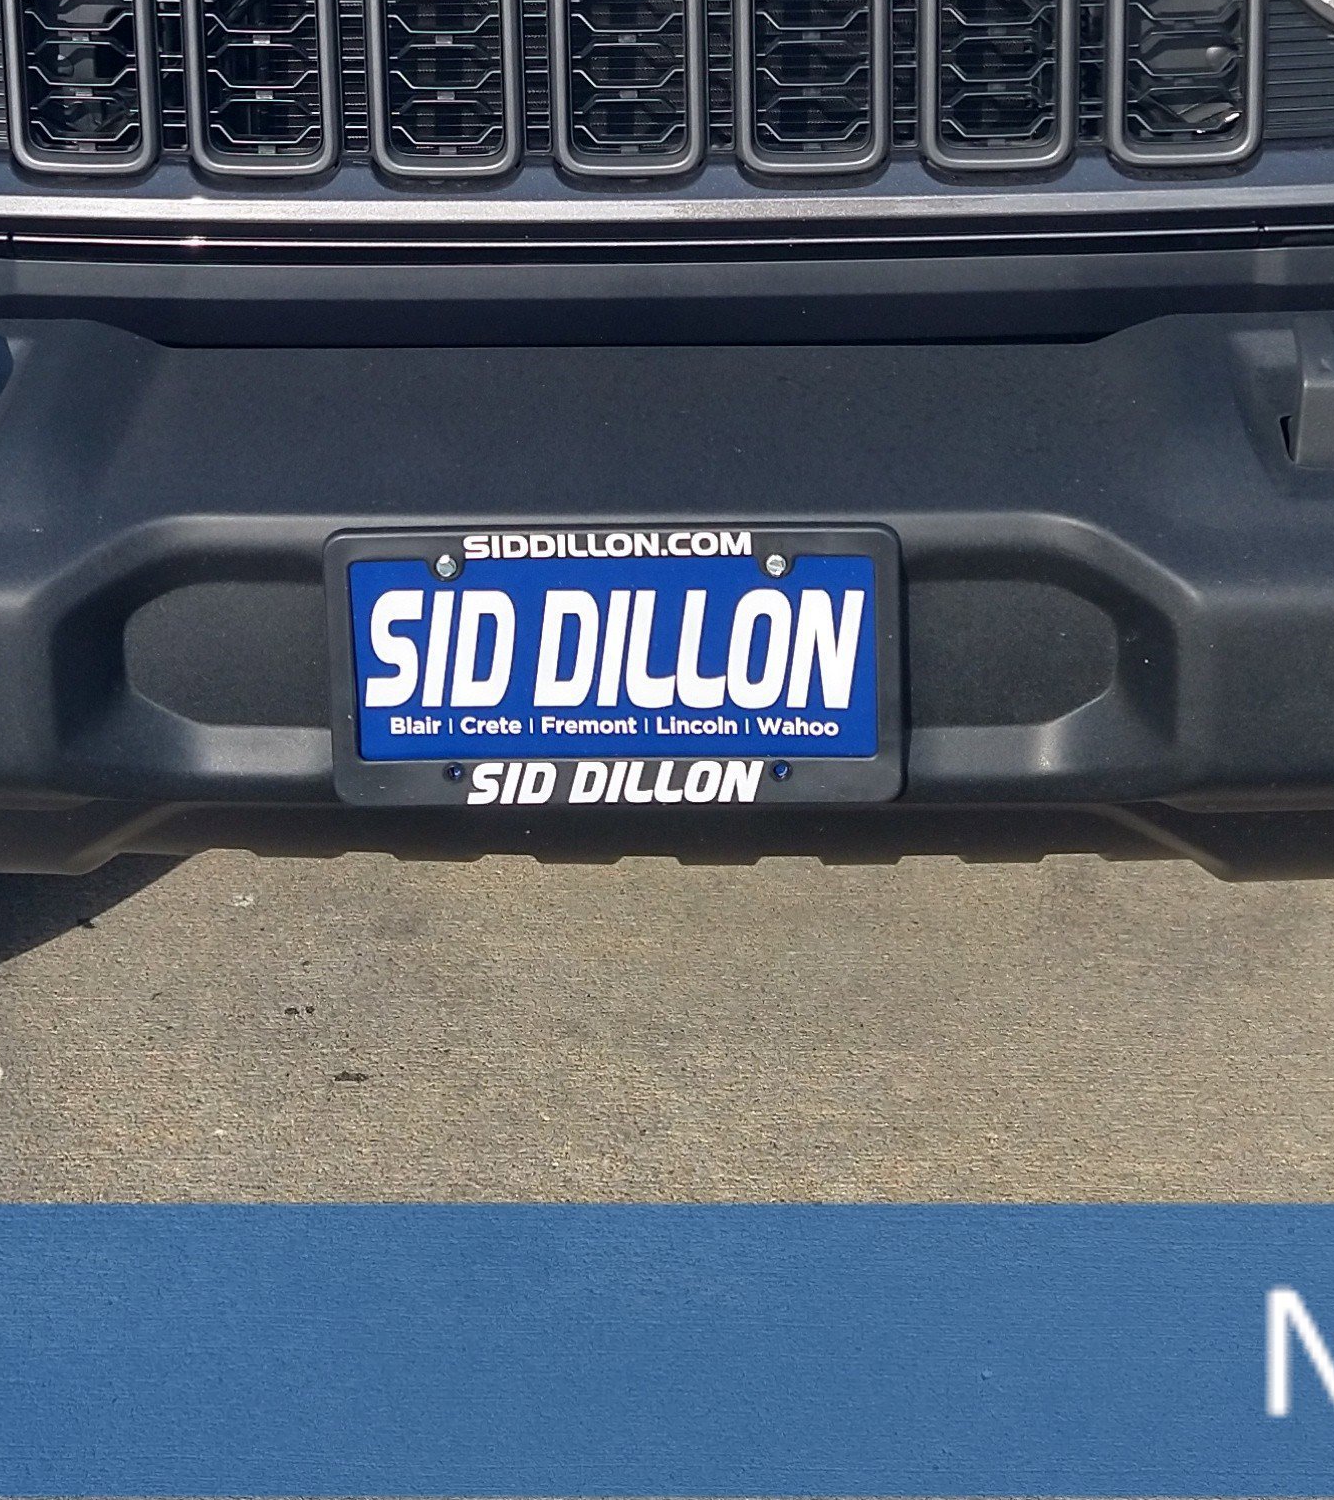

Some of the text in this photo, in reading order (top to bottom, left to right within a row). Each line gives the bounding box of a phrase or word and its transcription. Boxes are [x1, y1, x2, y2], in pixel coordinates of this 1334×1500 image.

[463, 532, 752, 559] SIDDILLON.COM
[365, 589, 865, 709] SID DILLON
[390, 716, 840, 736] Blair Crete Fremont Lincoln Wahoo
[467, 760, 765, 805] SID DILLON
